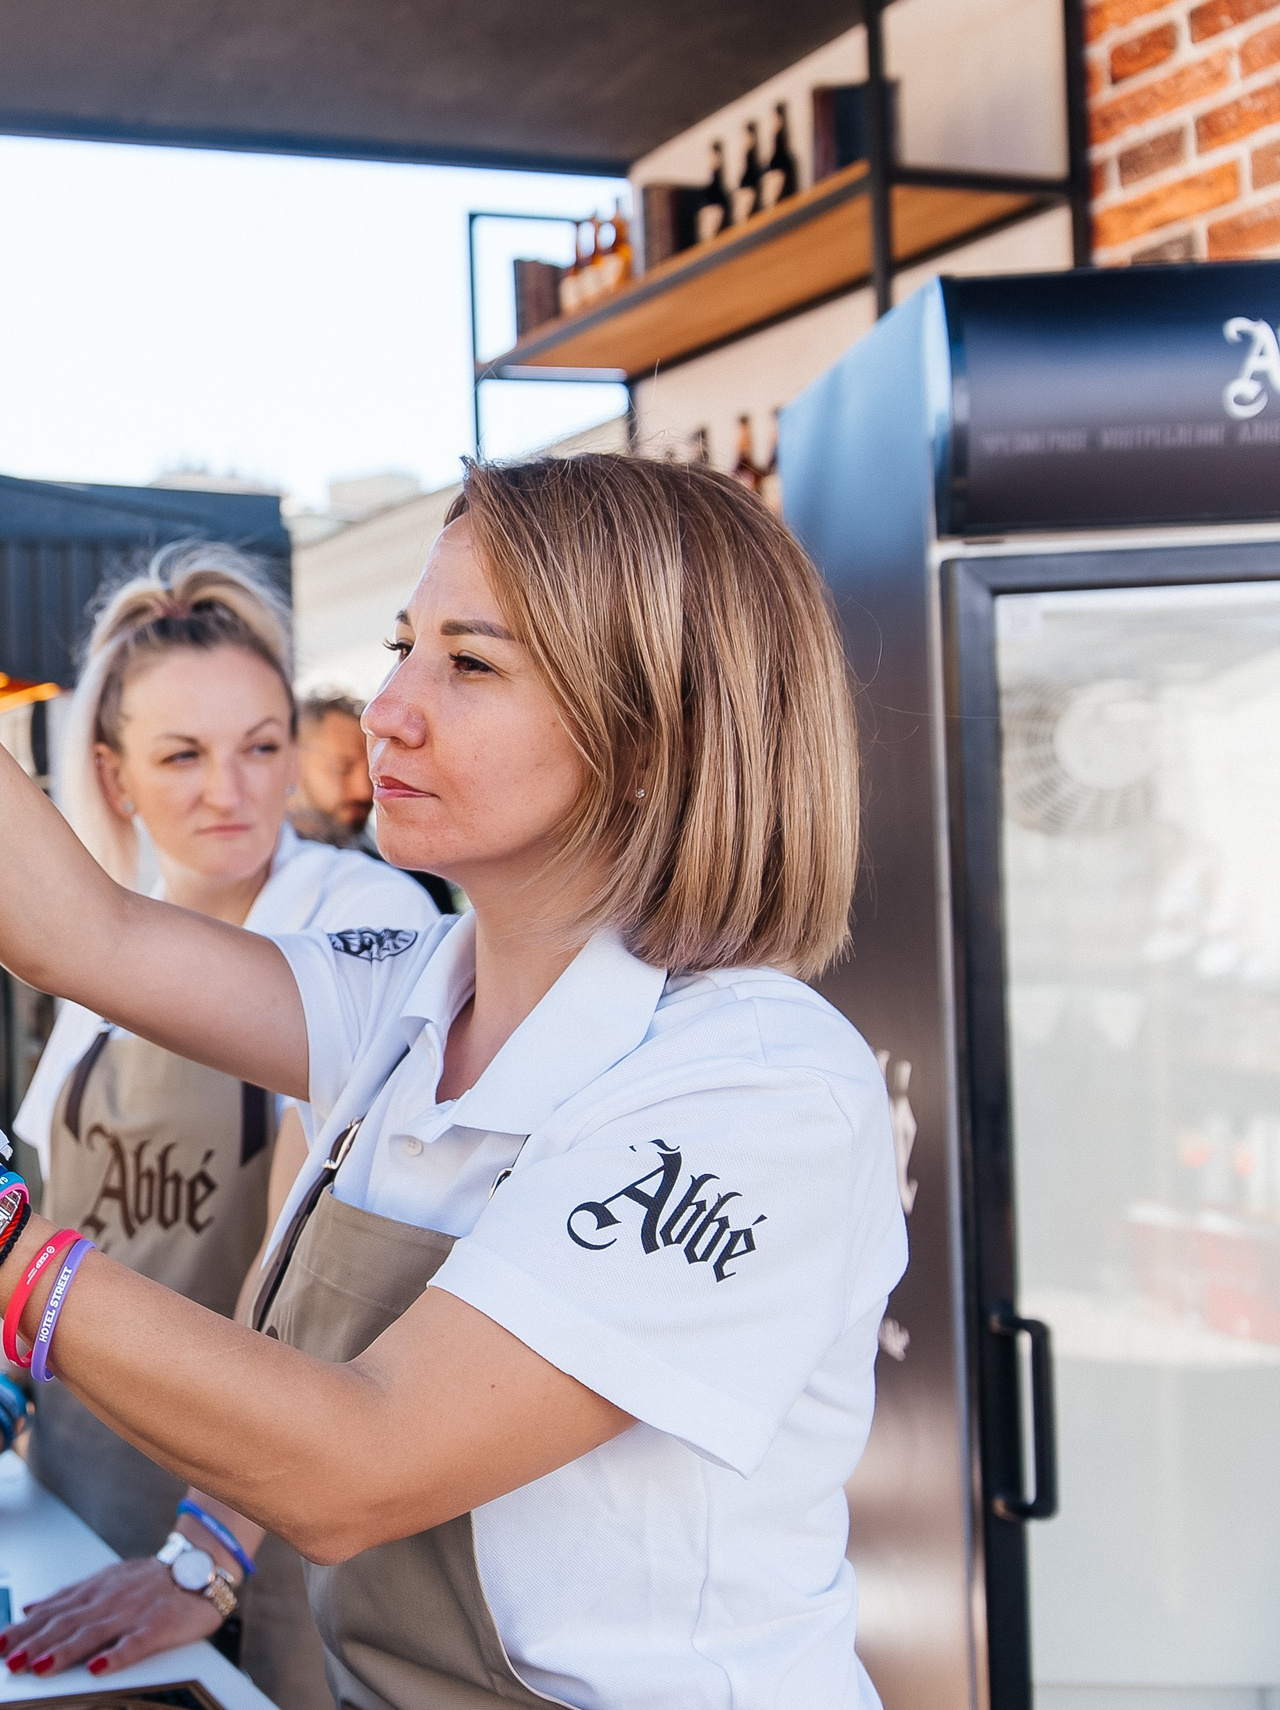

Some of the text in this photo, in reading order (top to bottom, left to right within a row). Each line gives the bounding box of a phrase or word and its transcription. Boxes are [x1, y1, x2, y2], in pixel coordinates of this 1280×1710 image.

[79, 1123, 218, 1246] Abbé
[566, 1138, 768, 1283] Abbé
[38, 1265, 73, 1343] HOTEL STREET
